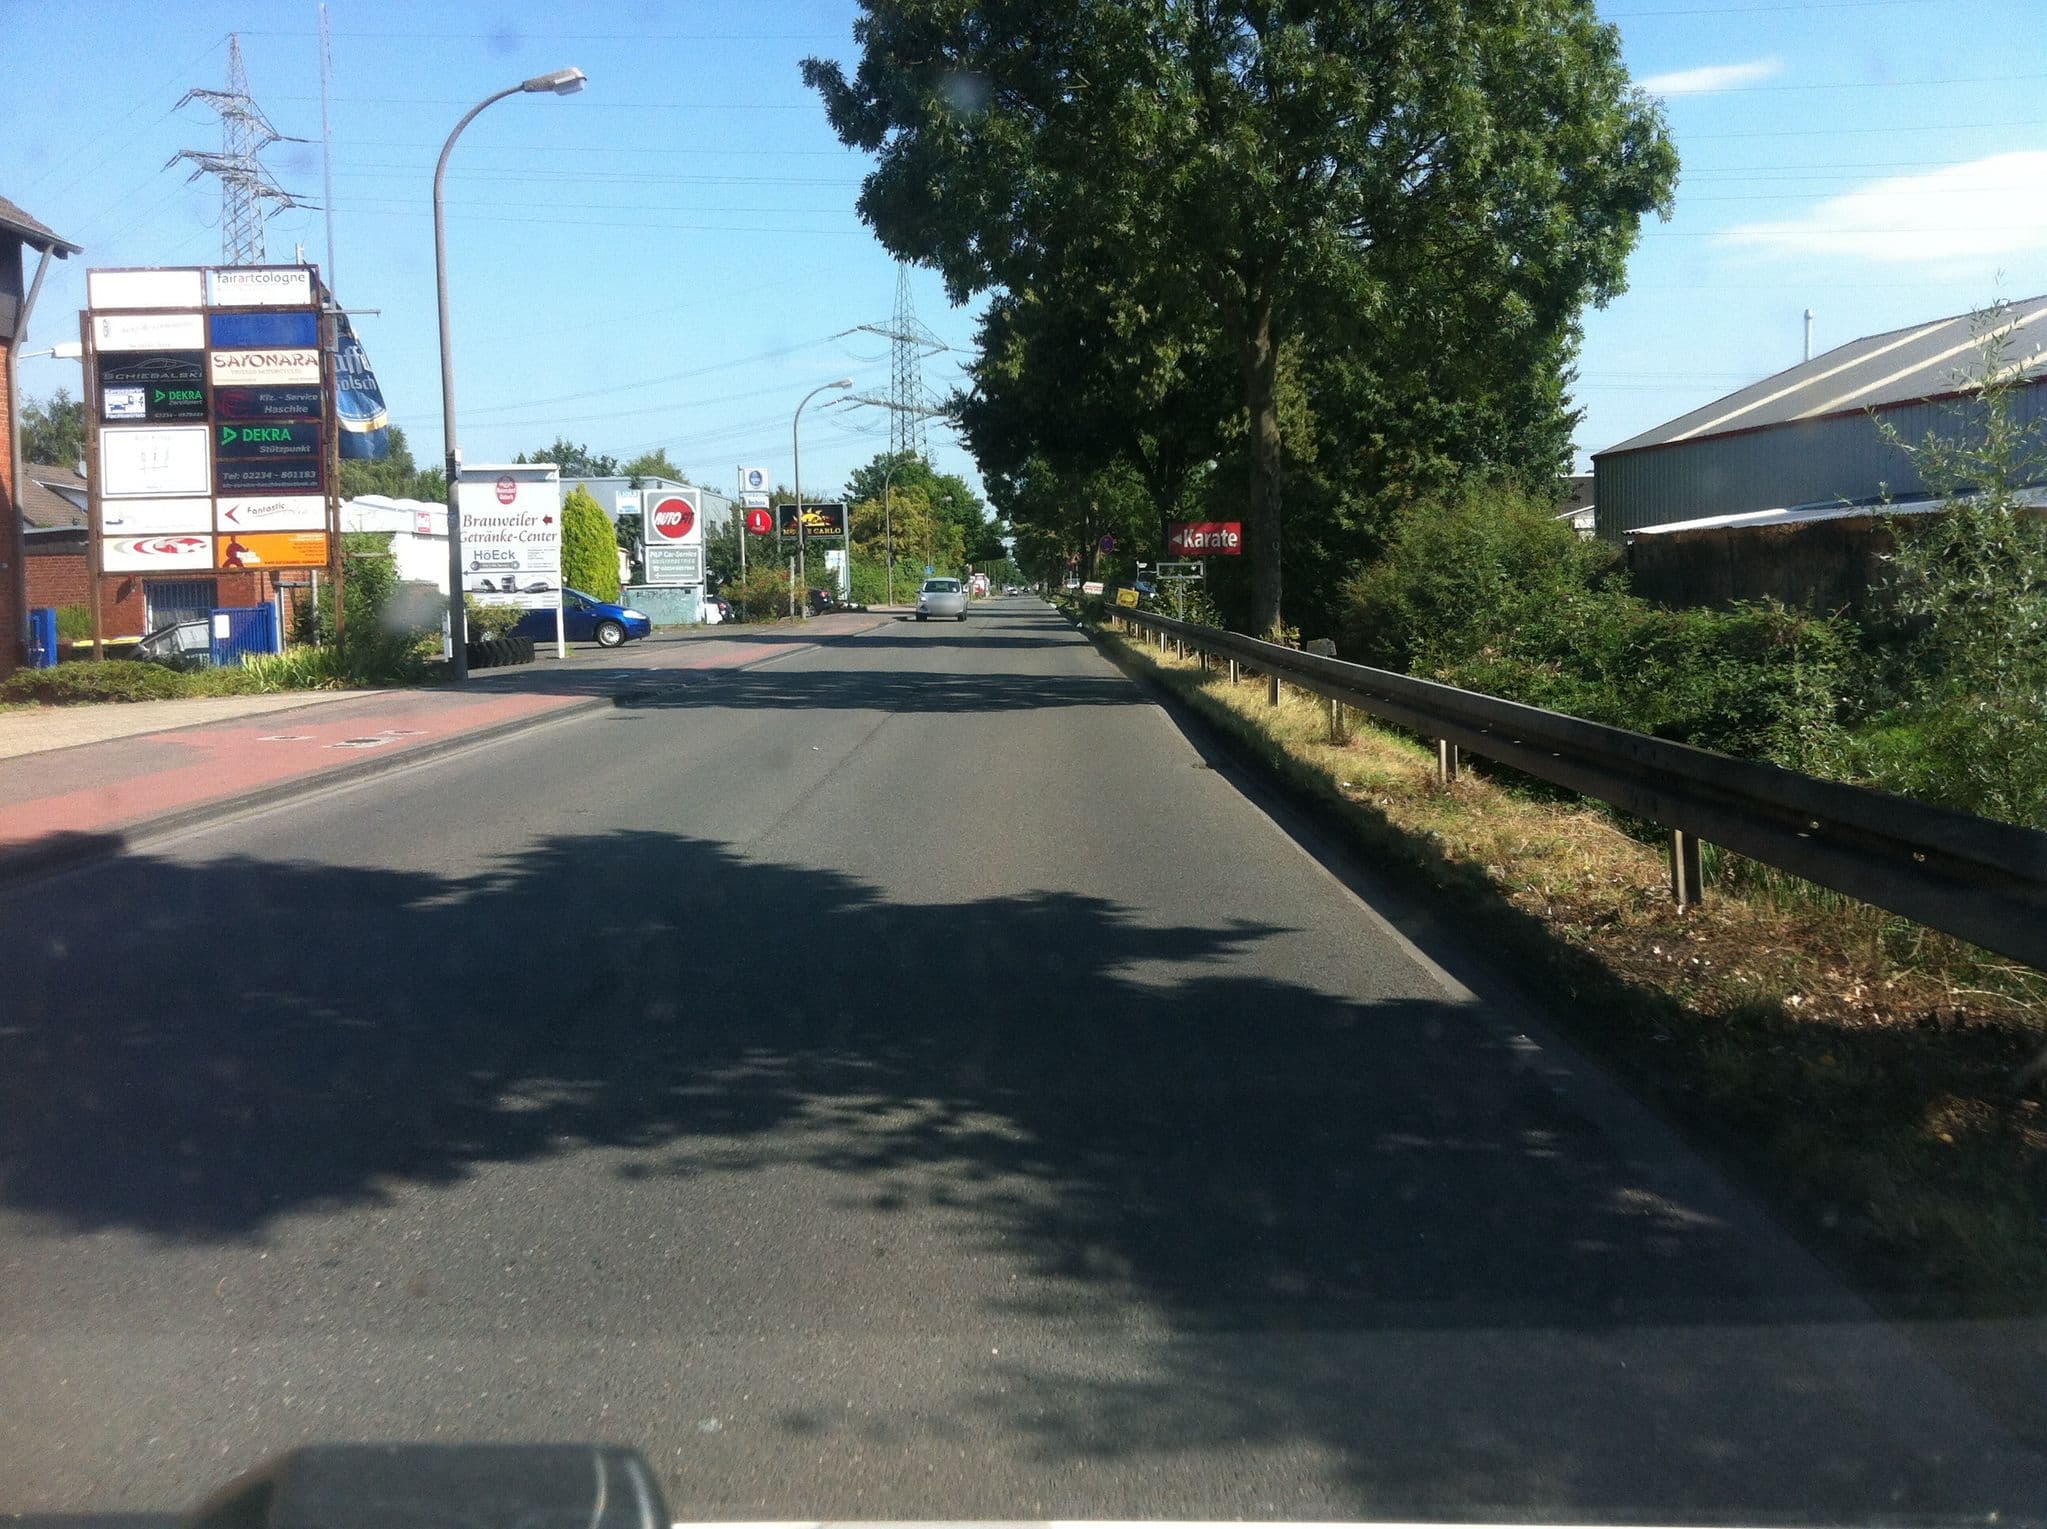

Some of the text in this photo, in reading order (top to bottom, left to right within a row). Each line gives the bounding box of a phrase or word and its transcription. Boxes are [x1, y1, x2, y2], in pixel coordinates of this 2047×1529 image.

[217, 272, 306, 285] fairartcologne
[214, 353, 319, 368] SAYONARA
[169, 390, 202, 400] DEKRA
[286, 393, 319, 401] Service
[264, 404, 309, 414] Haschke
[242, 428, 292, 442] DEKRA
[259, 445, 311, 454] Stützpunkt
[247, 501, 286, 515] Fantastic
[463, 511, 538, 527] Brauweiler
[460, 528, 558, 544] Getränke-Center
[813, 527, 842, 535] CARLO
[1183, 528, 1239, 548] Karate
[473, 549, 516, 561] HöEck
